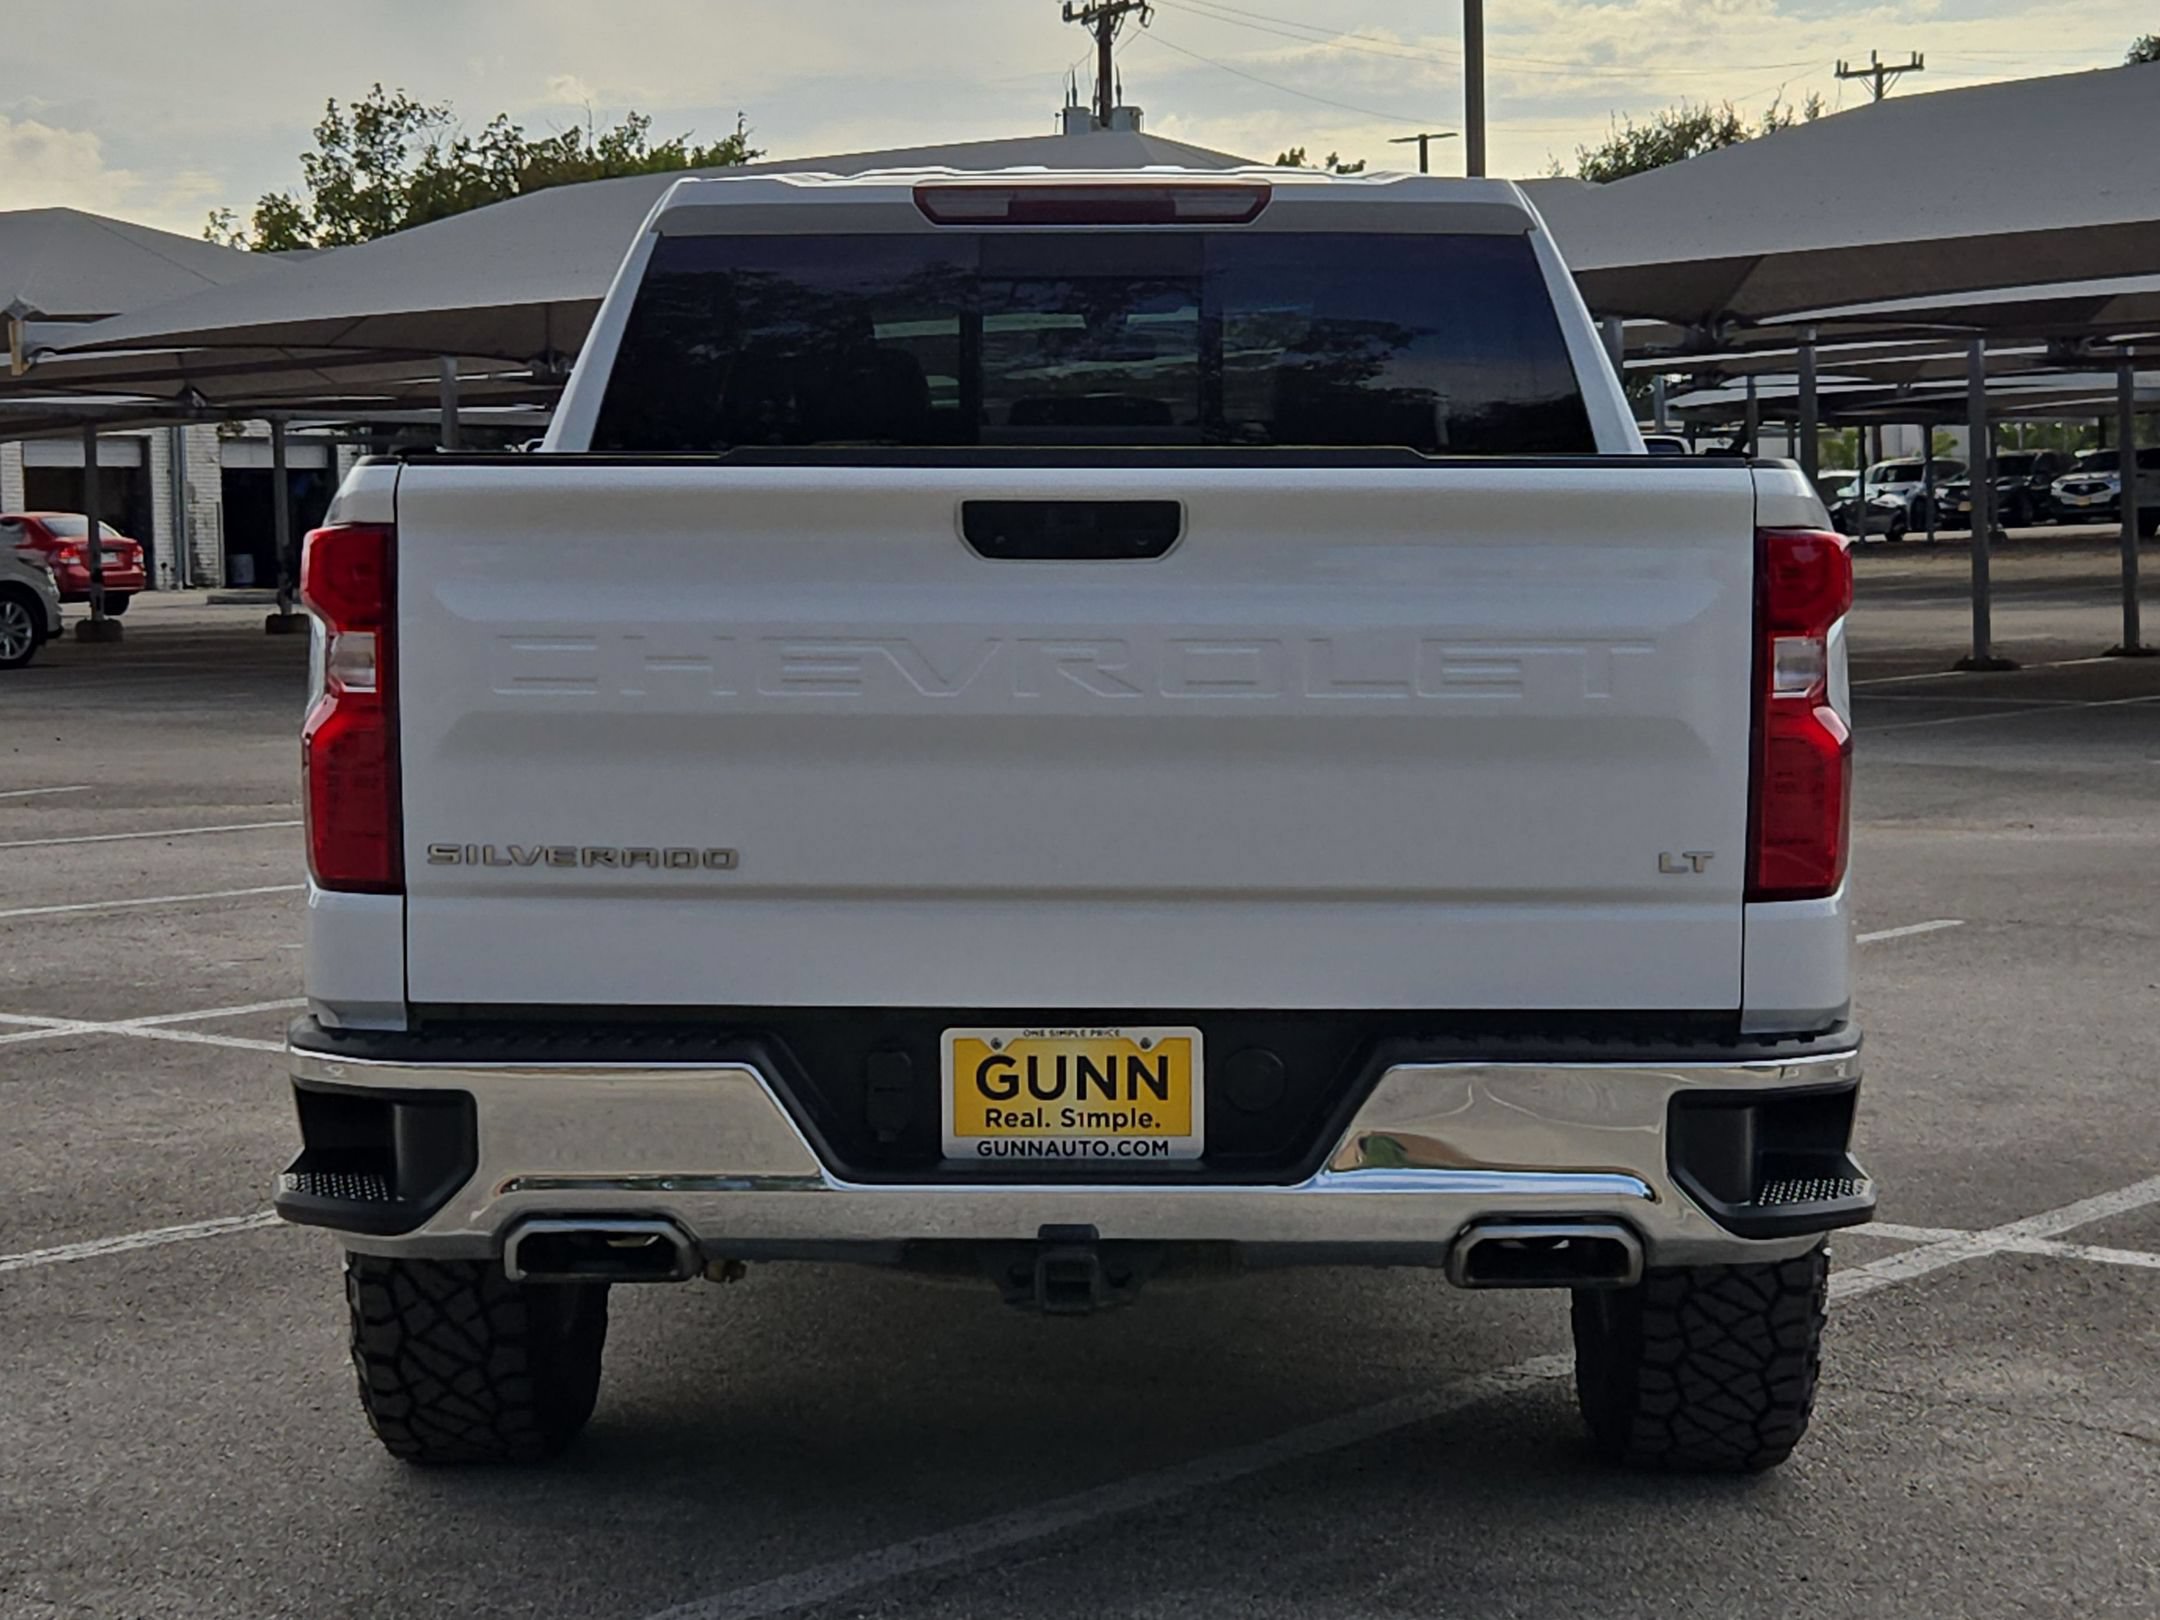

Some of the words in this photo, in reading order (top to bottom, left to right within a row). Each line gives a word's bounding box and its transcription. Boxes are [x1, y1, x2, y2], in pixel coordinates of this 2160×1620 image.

[493, 633, 1655, 699] CHEVROLET
[427, 843, 739, 870] SILVERADO
[1658, 851, 1714, 873] LT
[1023, 1029, 1045, 1037] ONE
[1049, 1029, 1086, 1037] SIMPLE
[1090, 1029, 1120, 1037] PRICE
[976, 1055, 1168, 1101] GUNN
[985, 1107, 1050, 1128] Real.
[977, 1140, 1169, 1157] GUNNAUTO.COM
